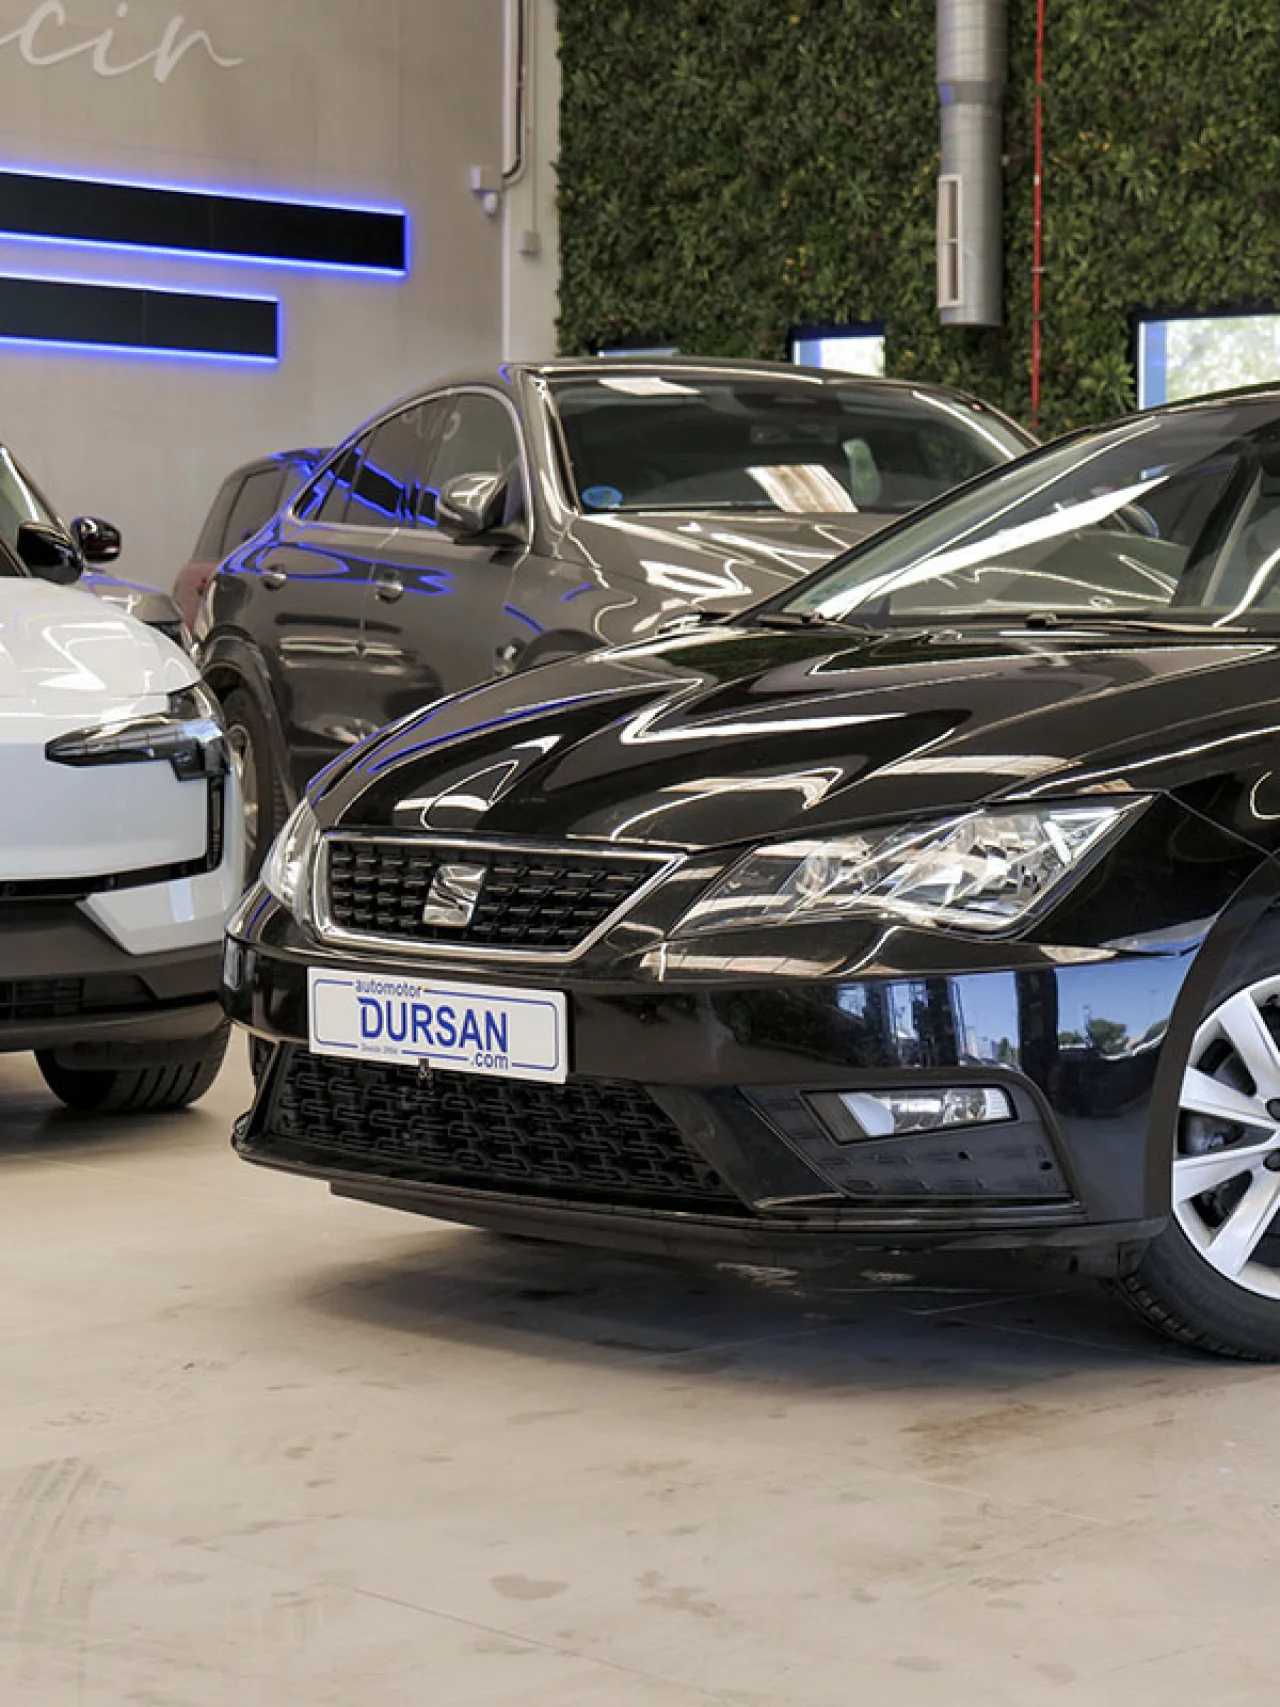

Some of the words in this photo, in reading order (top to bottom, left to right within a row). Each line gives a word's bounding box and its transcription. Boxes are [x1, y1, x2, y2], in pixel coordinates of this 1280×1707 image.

[355, 979, 422, 998] automotor
[358, 996, 508, 1052] DURSAN
[470, 1052, 509, 1069] .com
